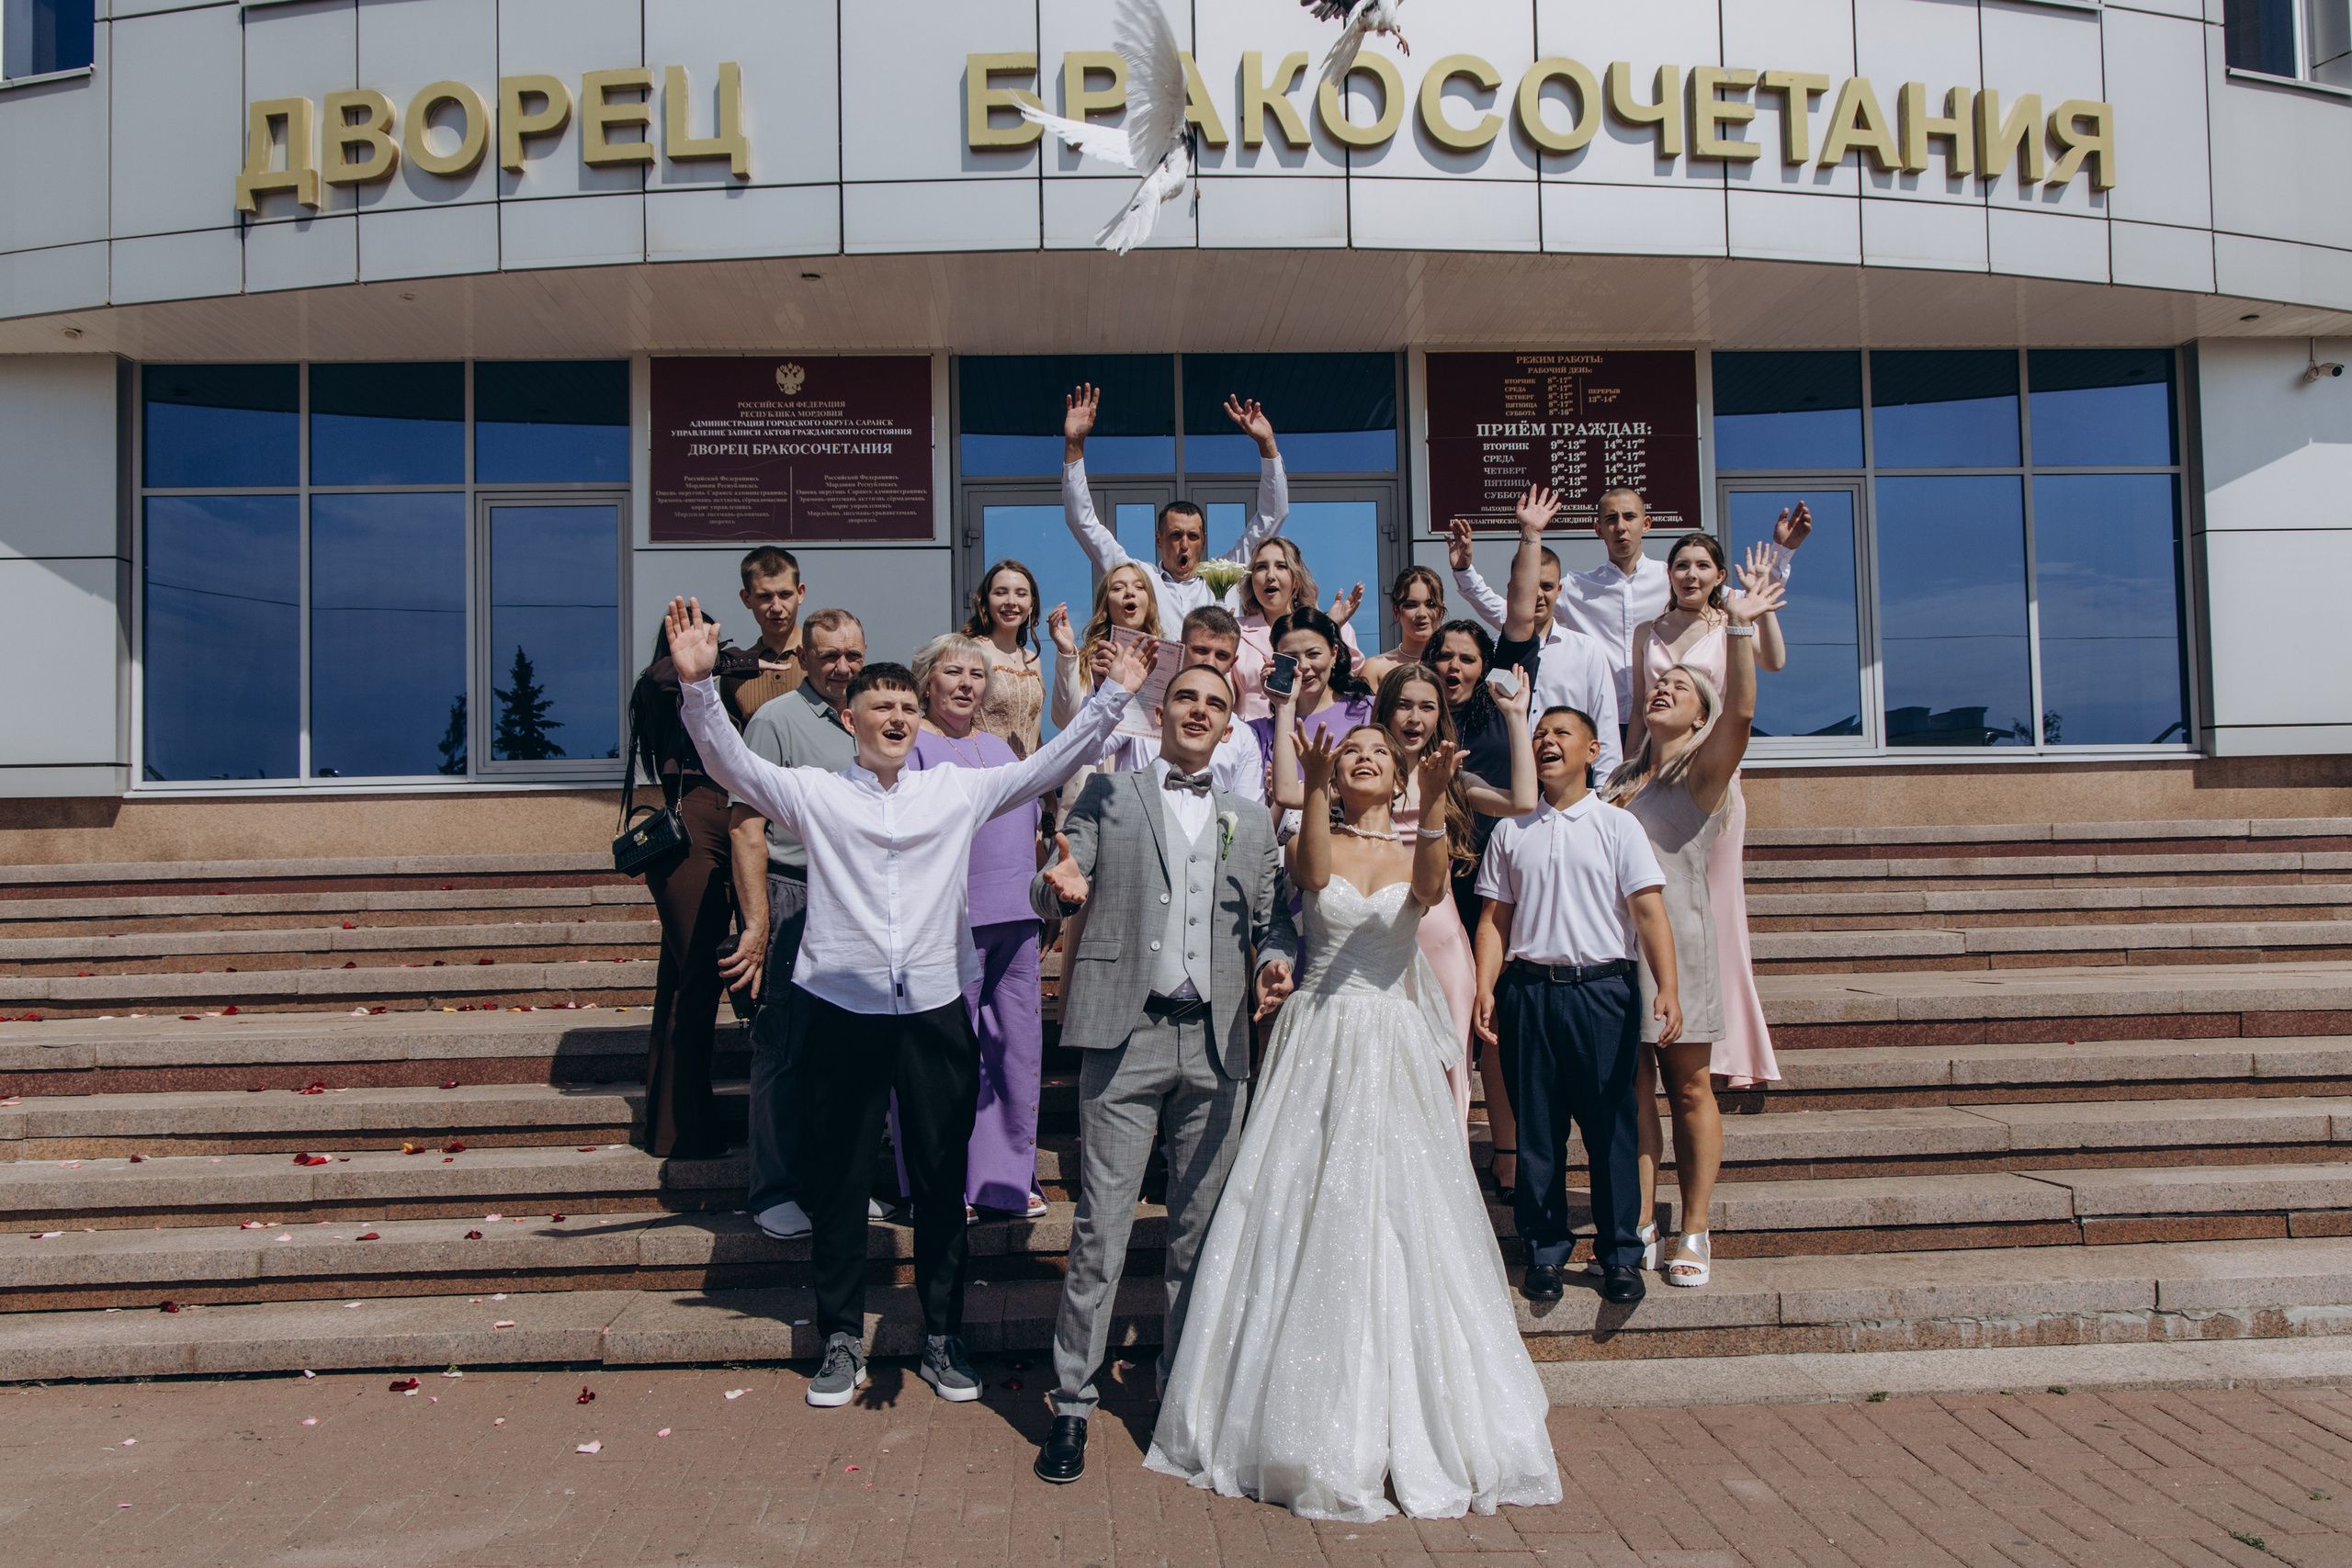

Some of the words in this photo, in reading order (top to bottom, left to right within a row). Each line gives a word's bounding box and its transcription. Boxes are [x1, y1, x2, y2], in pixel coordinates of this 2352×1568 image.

[235, 62, 751, 215] ДВОРЕЦ
[738, 400, 794, 409] РОССИЙСКАЯ
[797, 400, 845, 409] ФЕДЕРАЦИЯ
[1476, 421, 1546, 436] ПРИЁМ
[1551, 423, 1652, 438] ГРАЖДАН:
[688, 445, 748, 457] ДВОРЕЦ
[753, 443, 892, 455] БРАКОСОЧЕТАНИЯ
[1484, 479, 1532, 488] ПЯТНИЦА
